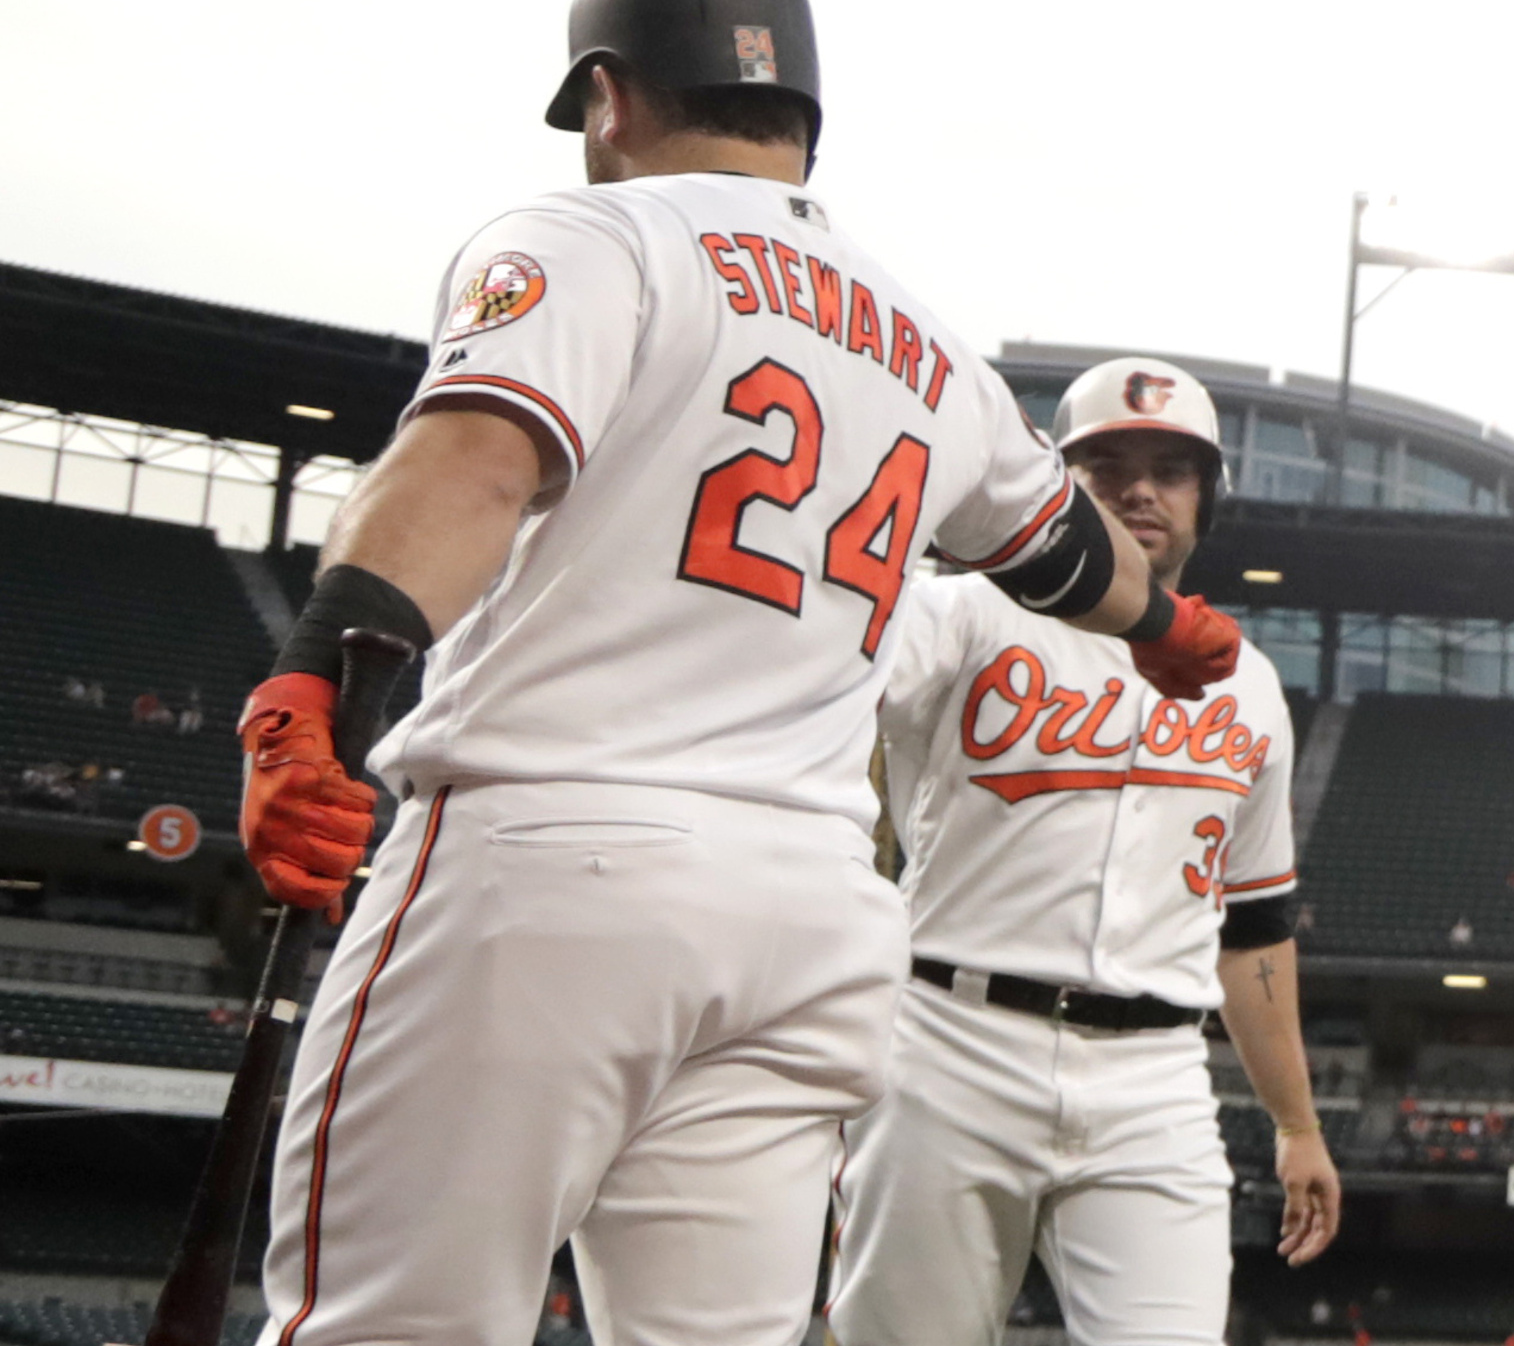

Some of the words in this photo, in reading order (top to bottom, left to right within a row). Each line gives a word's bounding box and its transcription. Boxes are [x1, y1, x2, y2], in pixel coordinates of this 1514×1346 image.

[734, 29, 774, 59] 24
[700, 232, 953, 413] STEWART
[677, 356, 931, 662] 24
[961, 645, 1270, 782] Orioles
[160, 816, 182, 849] 5
[1183, 815, 1231, 911] 3
